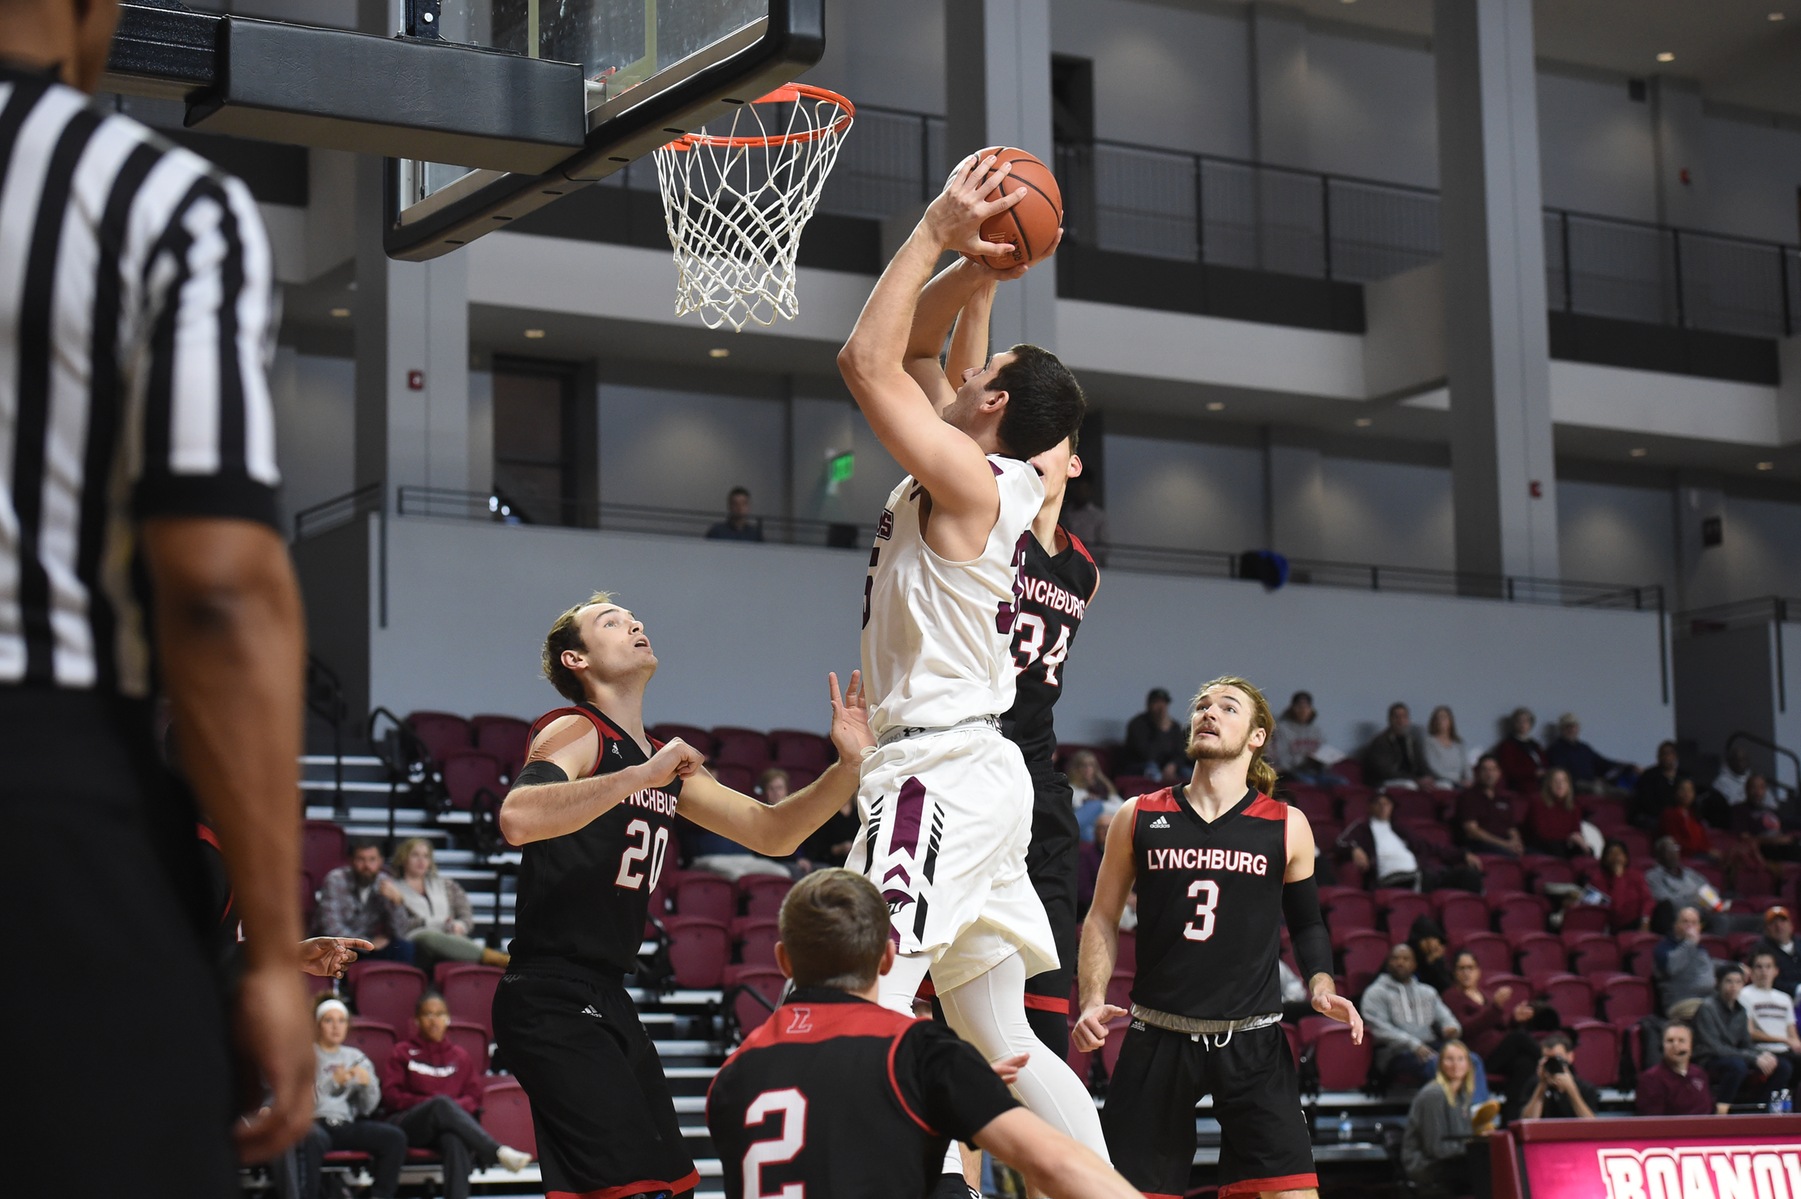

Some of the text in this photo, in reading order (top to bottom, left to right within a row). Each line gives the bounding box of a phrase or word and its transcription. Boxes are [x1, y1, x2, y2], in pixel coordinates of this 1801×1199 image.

[1012, 612, 1071, 687] 34
[614, 818, 669, 895] 20
[1147, 848, 1268, 876] LYNCHBURG
[1183, 879, 1219, 941] 3
[786, 1007, 813, 1034] L
[741, 1085, 809, 1199] 2
